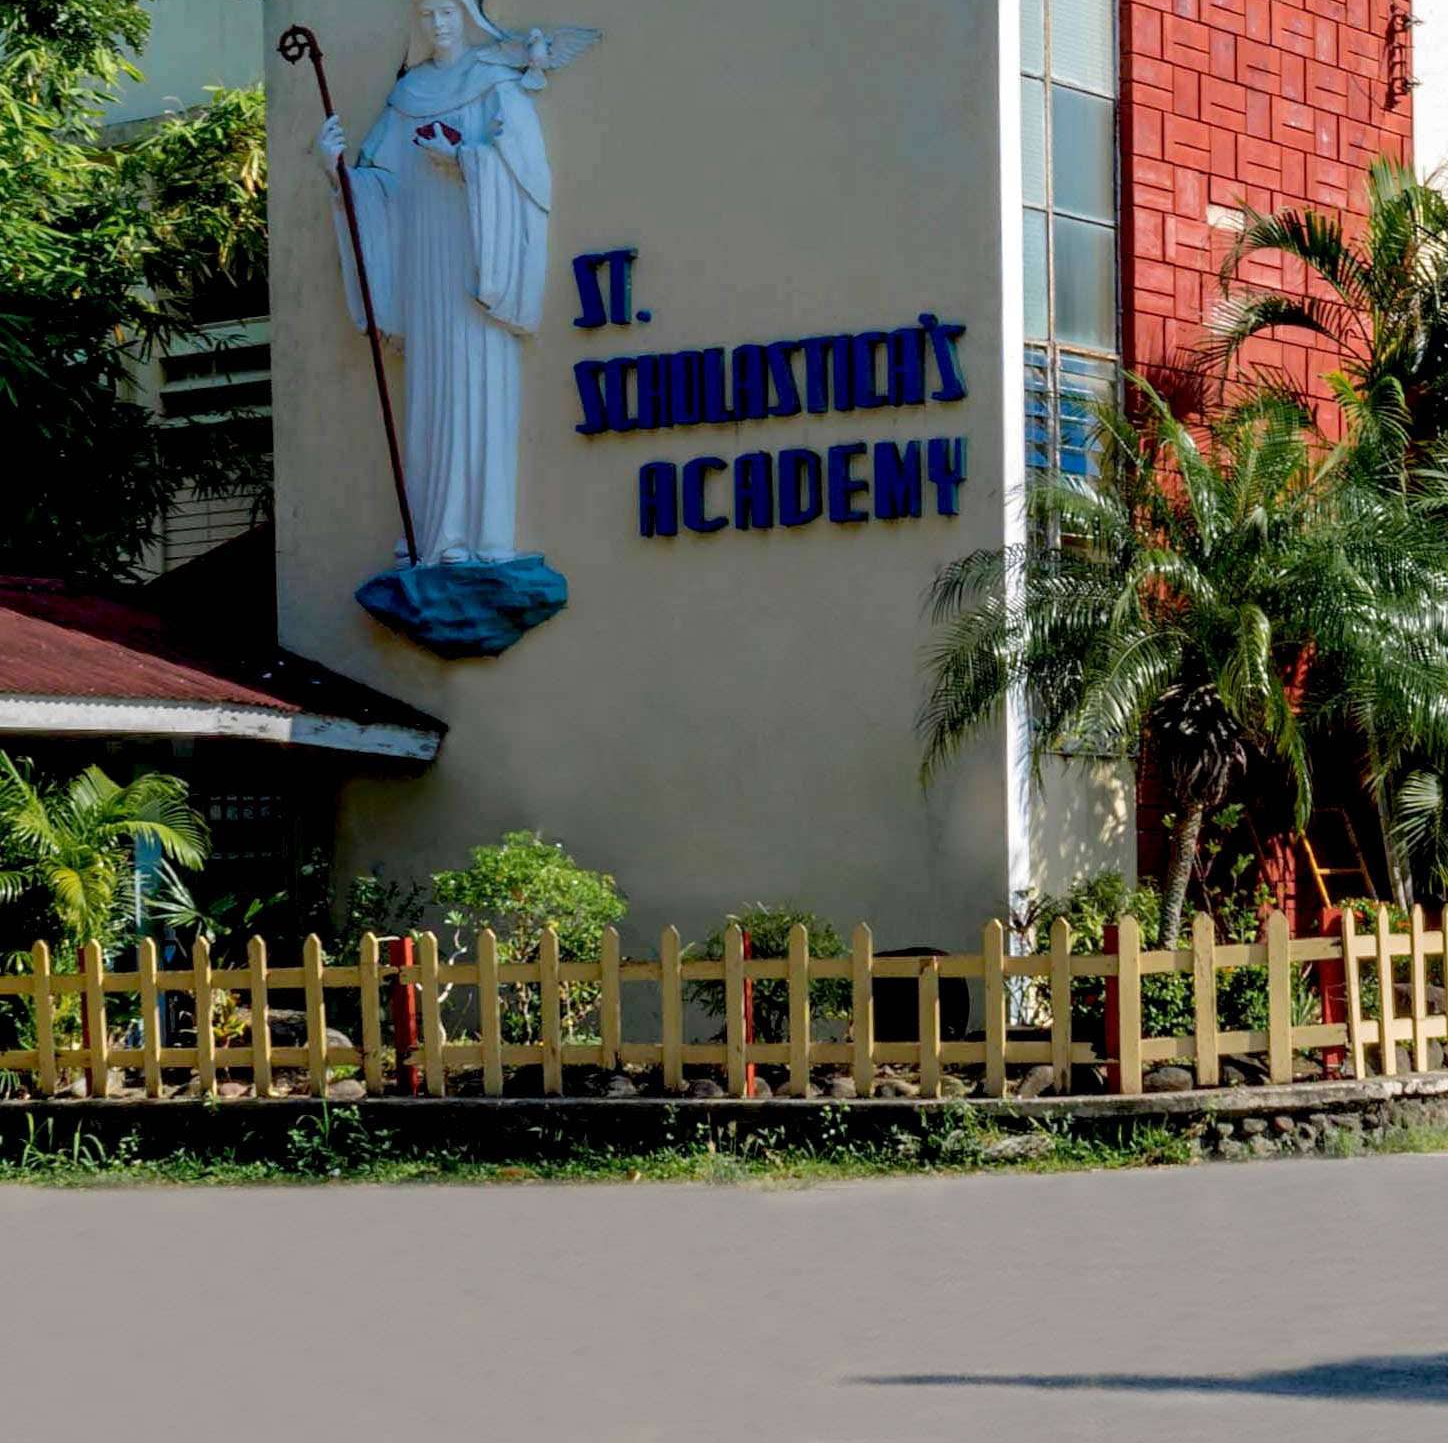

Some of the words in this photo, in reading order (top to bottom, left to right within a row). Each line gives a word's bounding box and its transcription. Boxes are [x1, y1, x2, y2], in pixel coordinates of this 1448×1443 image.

[572, 247, 652, 329] ST.
[573, 313, 969, 435] SCHOLASTICA'S
[639, 437, 968, 538] ACADEMY
